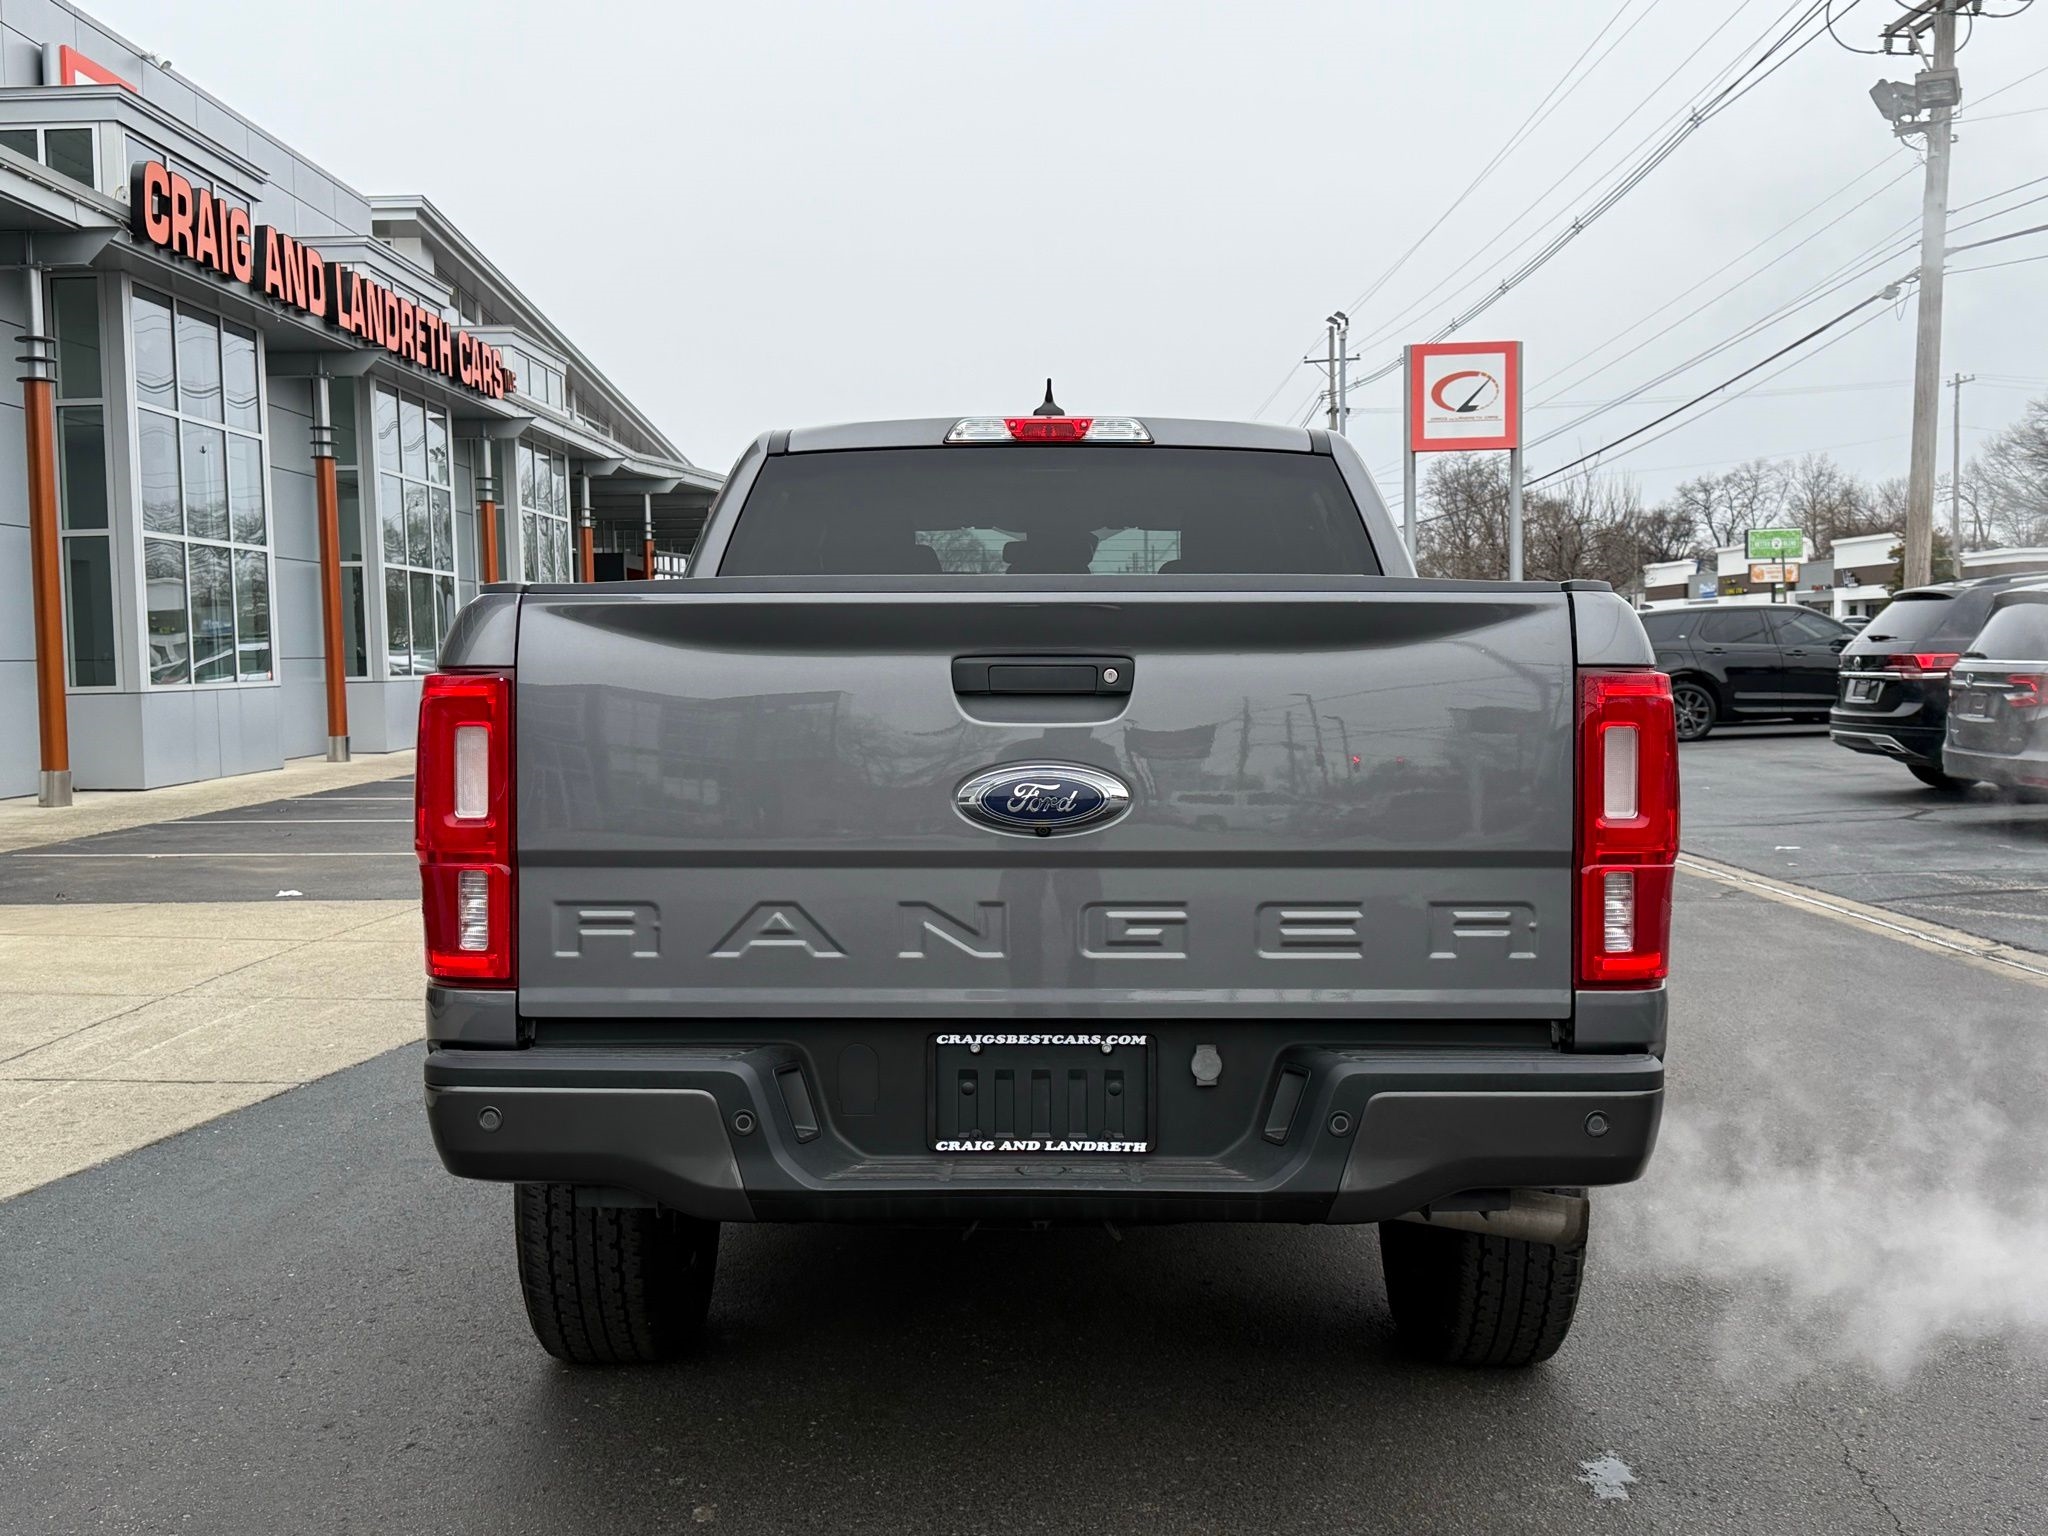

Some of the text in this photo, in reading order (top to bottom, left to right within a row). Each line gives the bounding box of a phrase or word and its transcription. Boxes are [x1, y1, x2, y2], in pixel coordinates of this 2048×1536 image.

[143, 160, 252, 284] CRAIG
[265, 225, 327, 317] AND
[335, 263, 453, 378] LANDRETH
[458, 330, 504, 399] CARS
[1007, 783, 1078, 813] Ford
[552, 899, 1539, 961] RANGER
[936, 1034, 1148, 1045] CRAIGSBESTCARS.COM
[935, 1140, 1148, 1152] CRAIG AND LANDRETH
